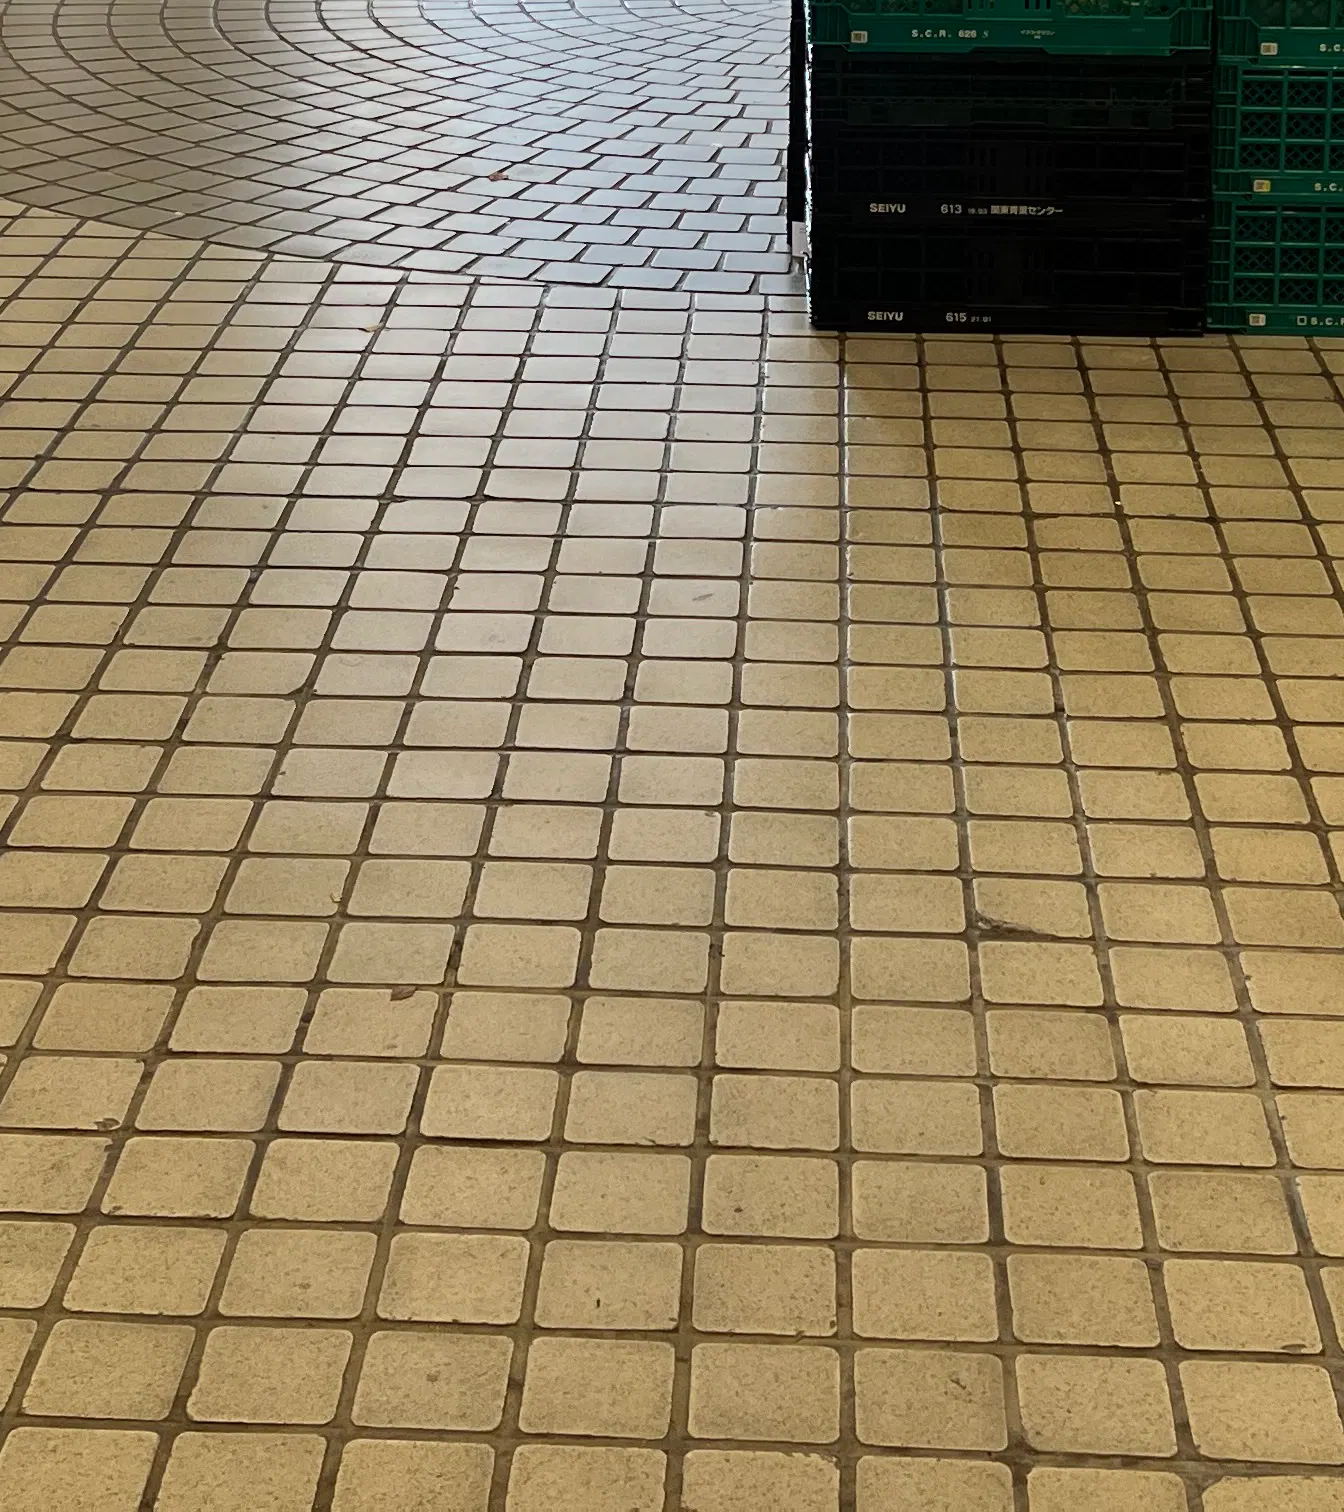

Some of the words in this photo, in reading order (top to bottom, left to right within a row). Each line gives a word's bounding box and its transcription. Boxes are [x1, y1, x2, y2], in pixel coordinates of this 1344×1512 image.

[869, 203, 906, 213] SEIYU
[940, 204, 963, 214] 613
[867, 311, 904, 321] SEIYU
[945, 312, 967, 322] 615
